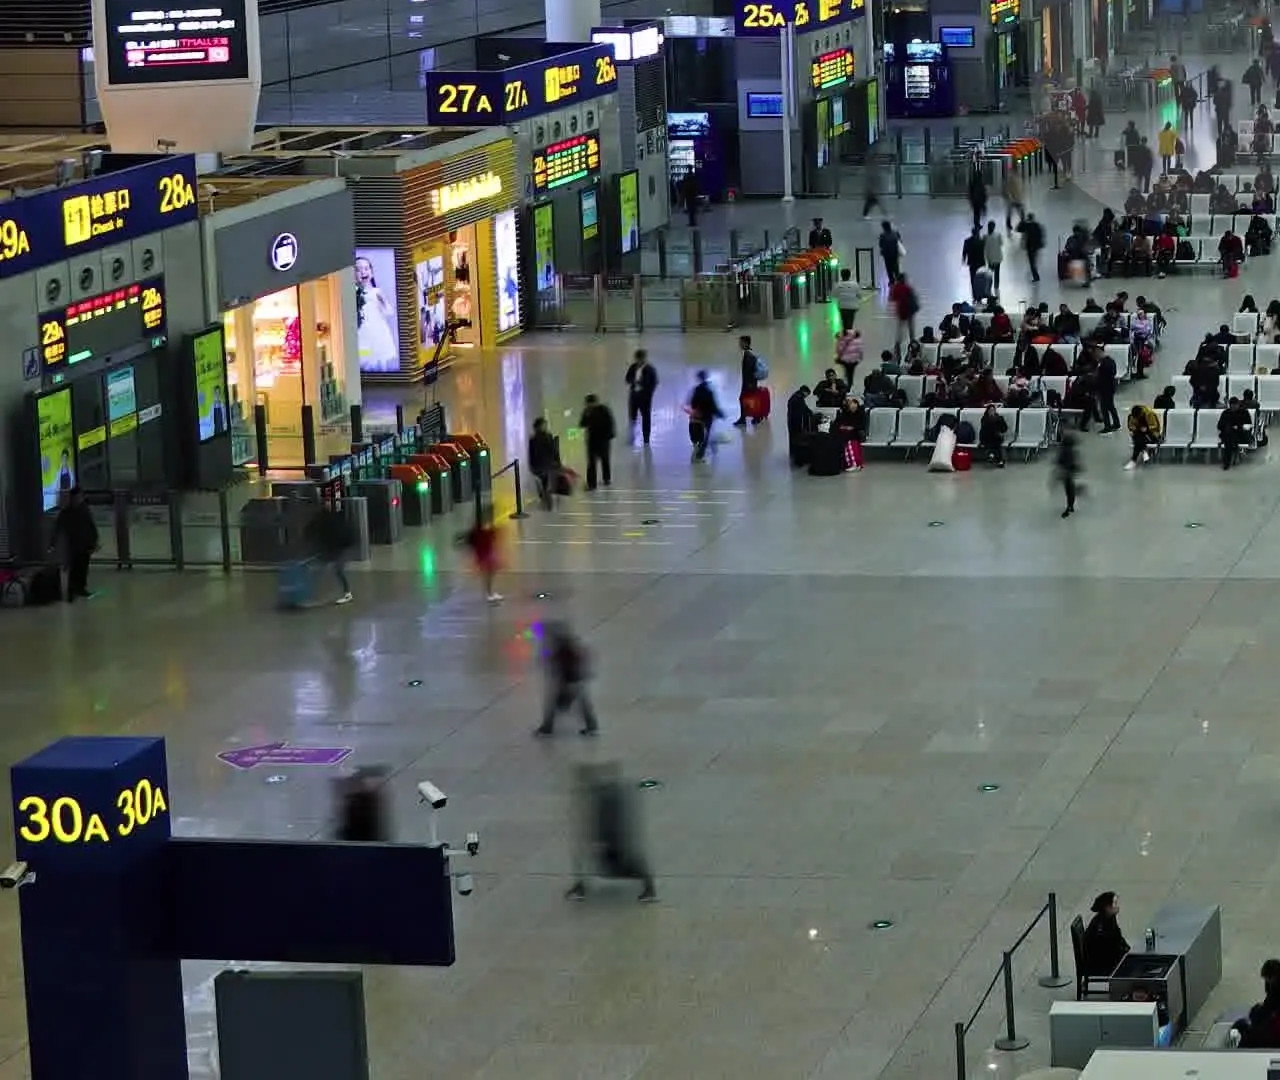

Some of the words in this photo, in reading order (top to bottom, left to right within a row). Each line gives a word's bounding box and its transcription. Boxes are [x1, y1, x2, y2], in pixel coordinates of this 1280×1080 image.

[744, 4, 785, 27] 25A
[439, 84, 492, 113] 27A
[505, 81, 528, 112] 27A
[596, 56, 616, 84] 26A
[0, 219, 30, 261] 9A
[90, 188, 130, 219] 检票口
[159, 173, 195, 213] 28A
[19, 796, 110, 843] 30A
[117, 778, 167, 836] 30A
